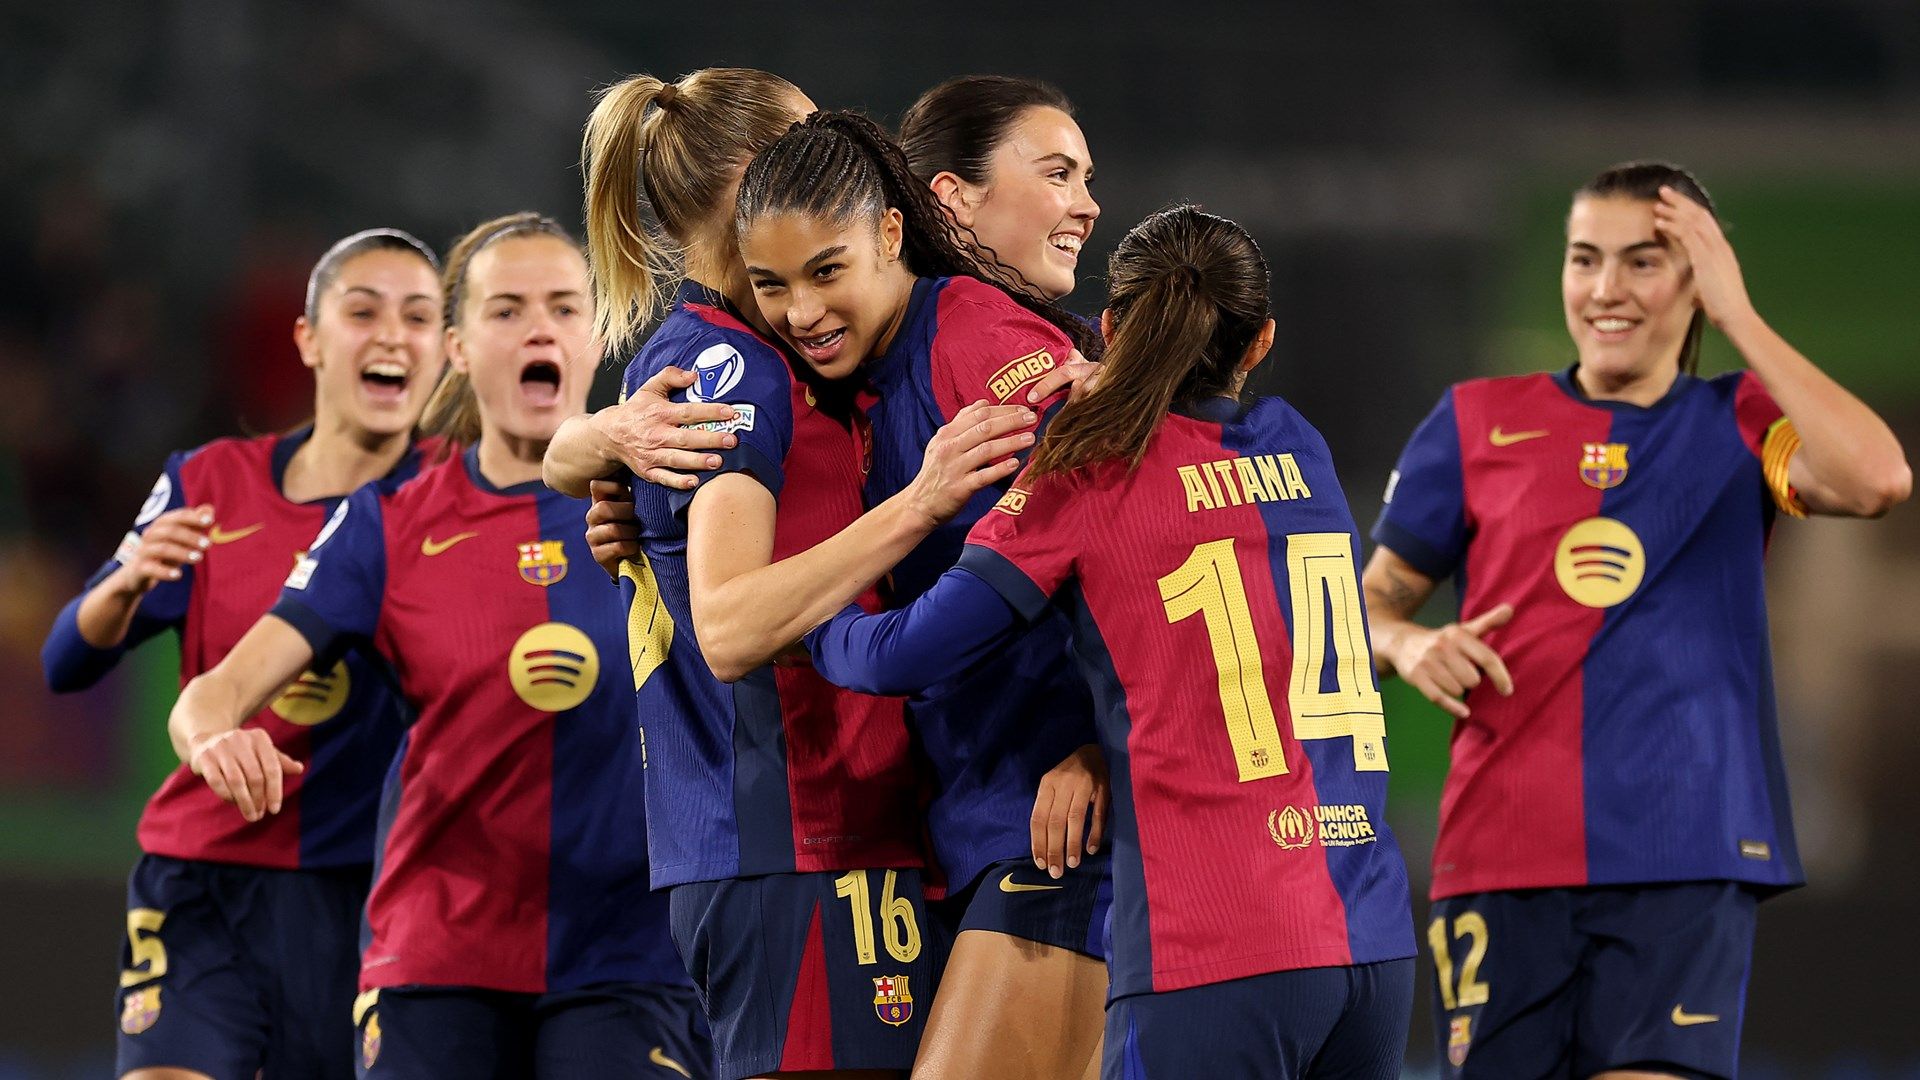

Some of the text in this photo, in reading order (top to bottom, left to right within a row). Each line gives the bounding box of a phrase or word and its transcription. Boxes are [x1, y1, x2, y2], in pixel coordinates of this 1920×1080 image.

[990, 351, 1054, 400] BIMBO
[1177, 453, 1312, 513] AITANA
[1157, 533, 1389, 783] 14
[1313, 805, 1368, 822] UNHCR
[1319, 821, 1375, 839] ACNUR
[120, 907, 168, 989] 5
[835, 869, 922, 965] 16
[1427, 911, 1490, 1011] 12
